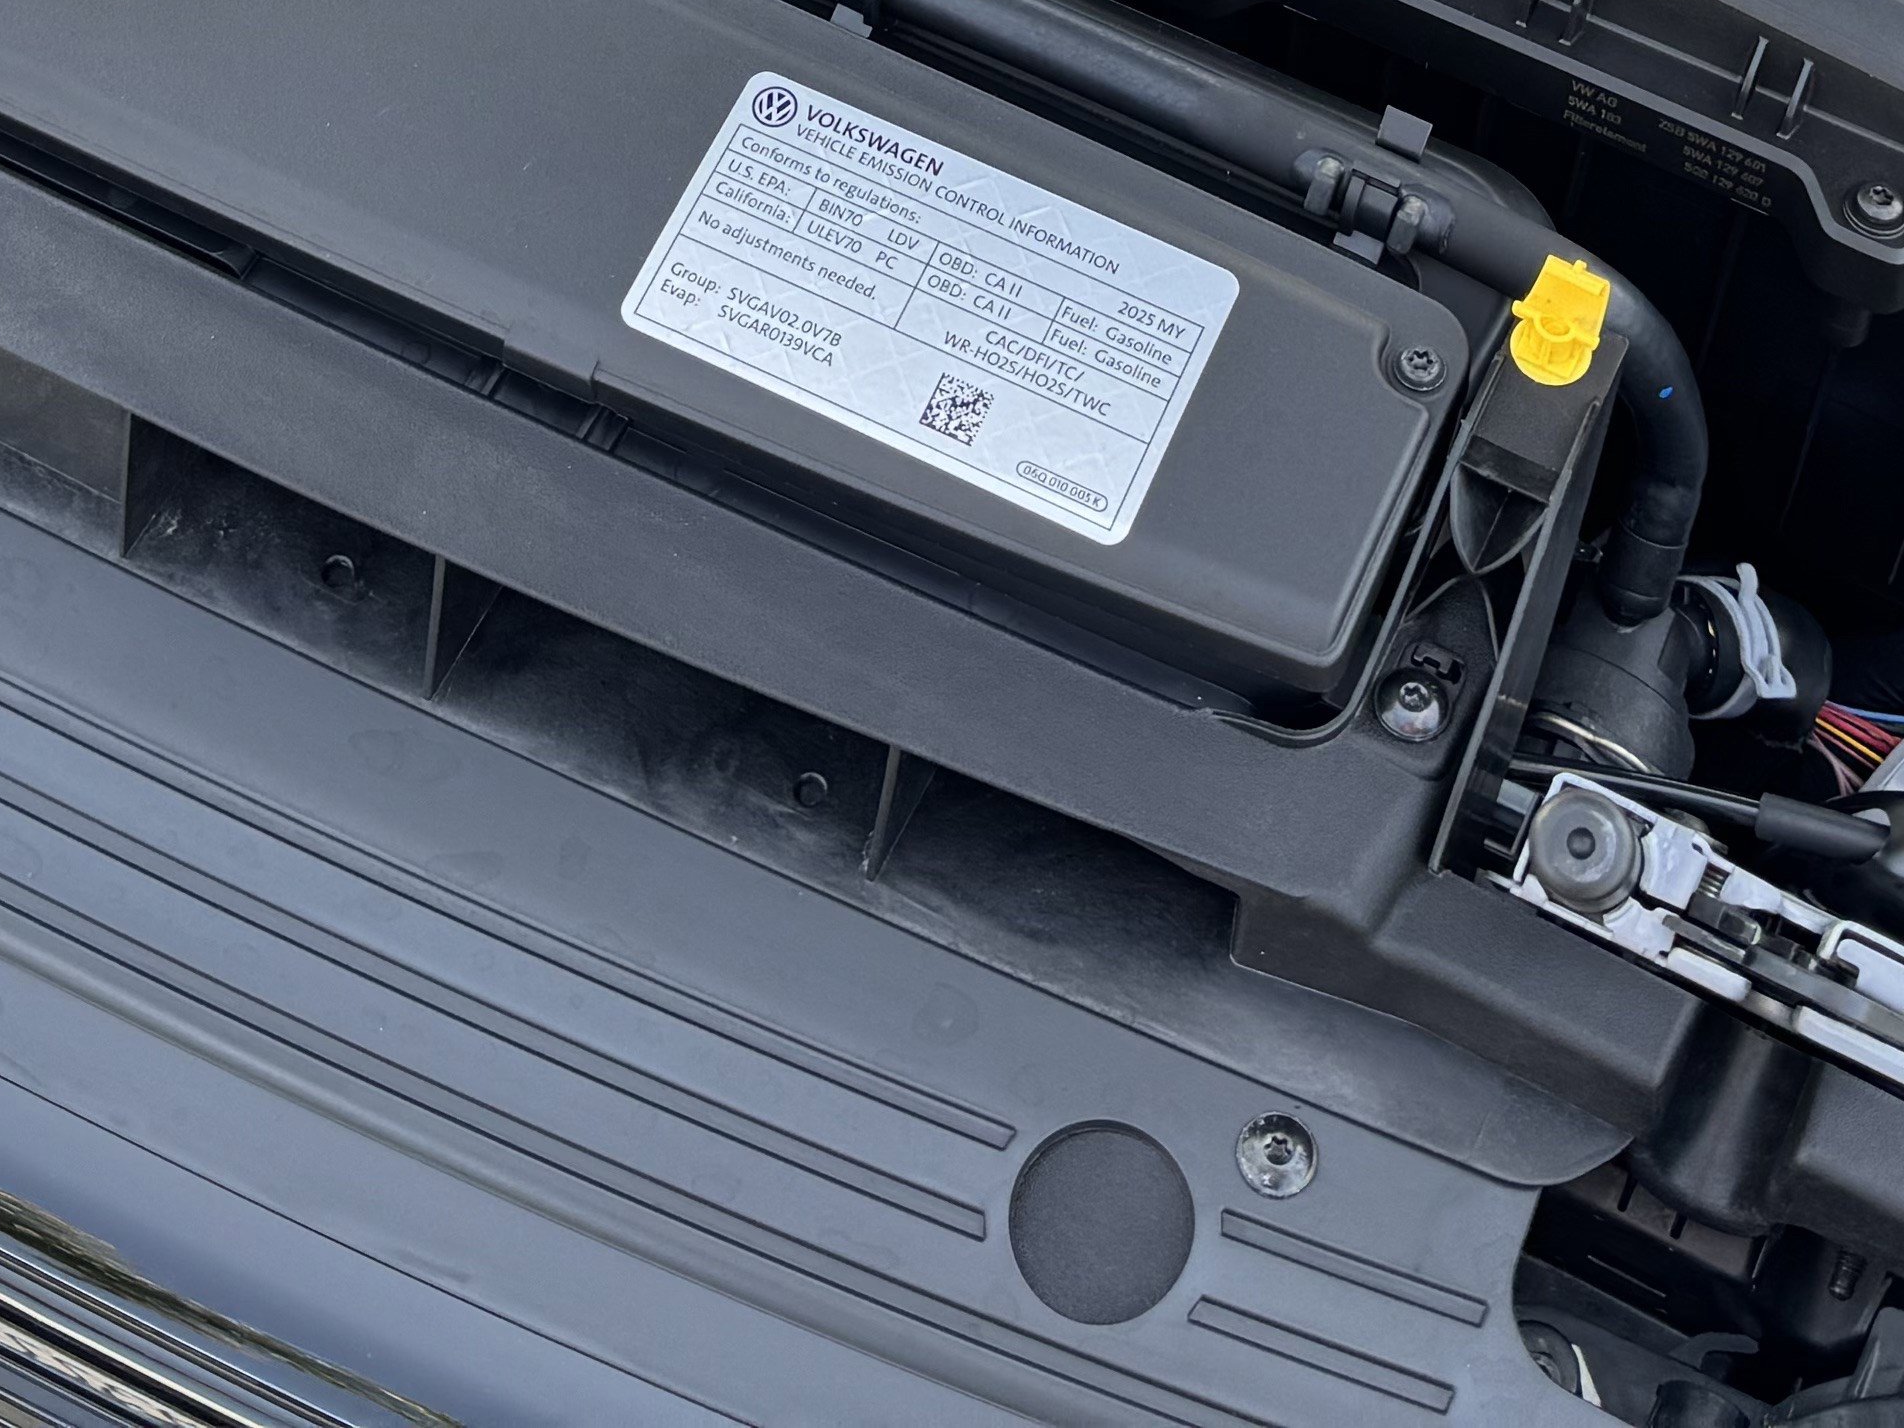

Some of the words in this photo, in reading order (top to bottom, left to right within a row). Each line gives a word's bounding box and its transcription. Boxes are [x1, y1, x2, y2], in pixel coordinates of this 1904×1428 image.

[1571, 80, 1595, 97] VW
[807, 104, 944, 176] VOLKSWAGEN
[728, 158, 753, 180] U.S.
[757, 171, 790, 196] EPA:
[741, 136, 812, 175] Conforms
[814, 167, 830, 183] to
[832, 178, 921, 224] regulations:
[797, 123, 857, 159] VEHICLE
[858, 151, 933, 192] EMISSION
[934, 185, 1004, 226] CONTROL
[1008, 217, 1120, 274] INFORMATION
[715, 181, 790, 223] California:
[818, 198, 863, 227] BIN70
[887, 228, 920, 250] LDV
[698, 210, 720, 229] No
[722, 223, 816, 272] adjustments
[817, 266, 876, 300] needed.
[807, 220, 862, 253] ULEV70
[875, 250, 898, 270] PC
[660, 278, 700, 306] Evap:
[670, 262, 721, 294] Group:
[927, 274, 966, 300] OBD:
[973, 294, 994, 313] CA
[997, 304, 1011, 320] II
[939, 252, 977, 278] OBD:
[984, 272, 1005, 291] CA
[1009, 283, 1023, 297] II
[1061, 305, 1098, 332] Fuel:
[1105, 326, 1172, 365] Gasoline
[1117, 301, 1156, 326] 2025
[1156, 318, 1186, 339] MY
[985, 330, 1085, 382] CAC/DFI/TC/
[1050, 328, 1087, 355] Fuel:
[1094, 349, 1161, 388] Gasoline
[1048, 476, 1069, 492] 010
[1092, 496, 1101, 507] K
